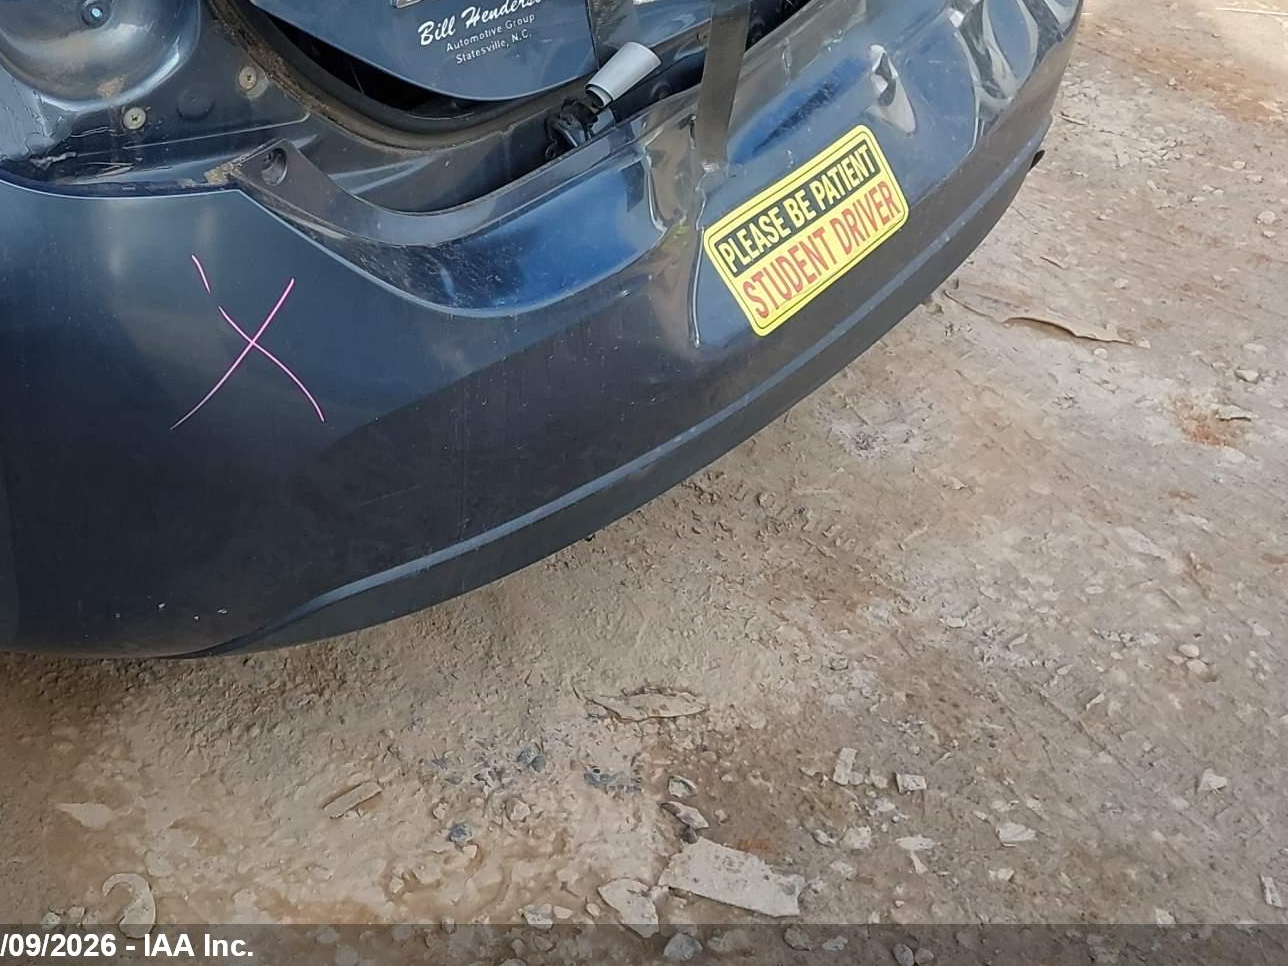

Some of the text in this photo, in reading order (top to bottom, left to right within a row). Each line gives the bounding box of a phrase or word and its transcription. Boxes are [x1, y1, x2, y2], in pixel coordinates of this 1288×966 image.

[417, 14, 456, 47] Bill
[446, 13, 535, 53] Automotive Group
[455, 29, 532, 64] Statesville, N.C.
[718, 144, 876, 273] PLEASE BE PATIENT
[743, 180, 902, 319] STUDENT DRIVER
